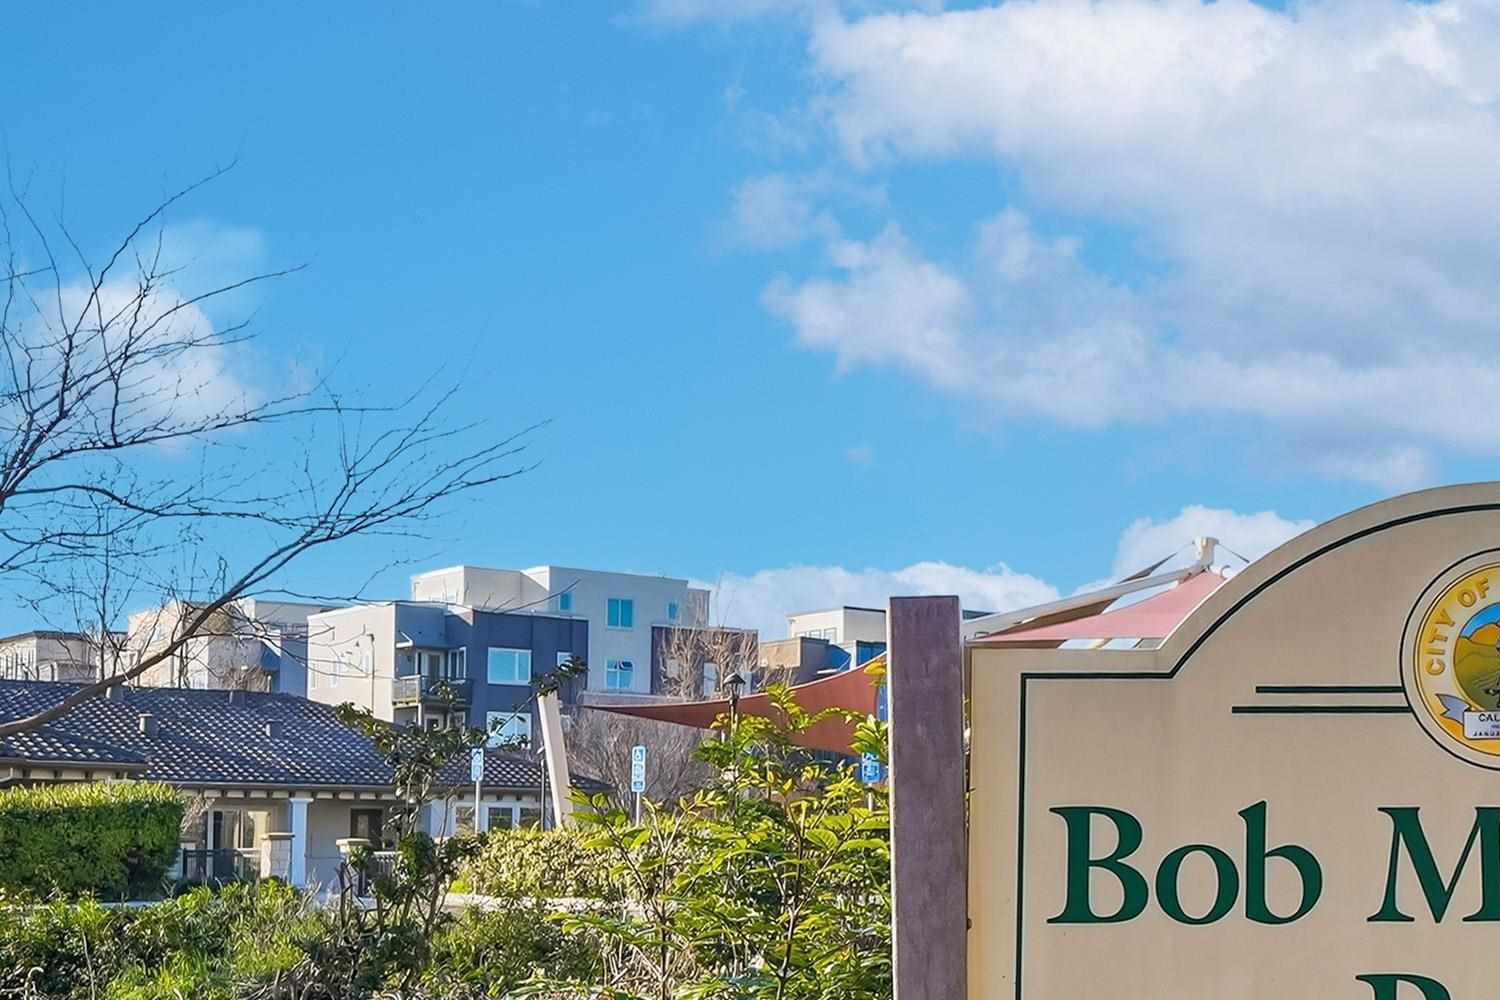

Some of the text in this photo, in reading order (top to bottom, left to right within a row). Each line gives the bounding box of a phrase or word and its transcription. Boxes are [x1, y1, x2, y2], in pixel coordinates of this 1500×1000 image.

[1425, 609, 1456, 676] CITY
[1458, 578, 1490, 608] OF
[1047, 801, 1322, 925] Bob
